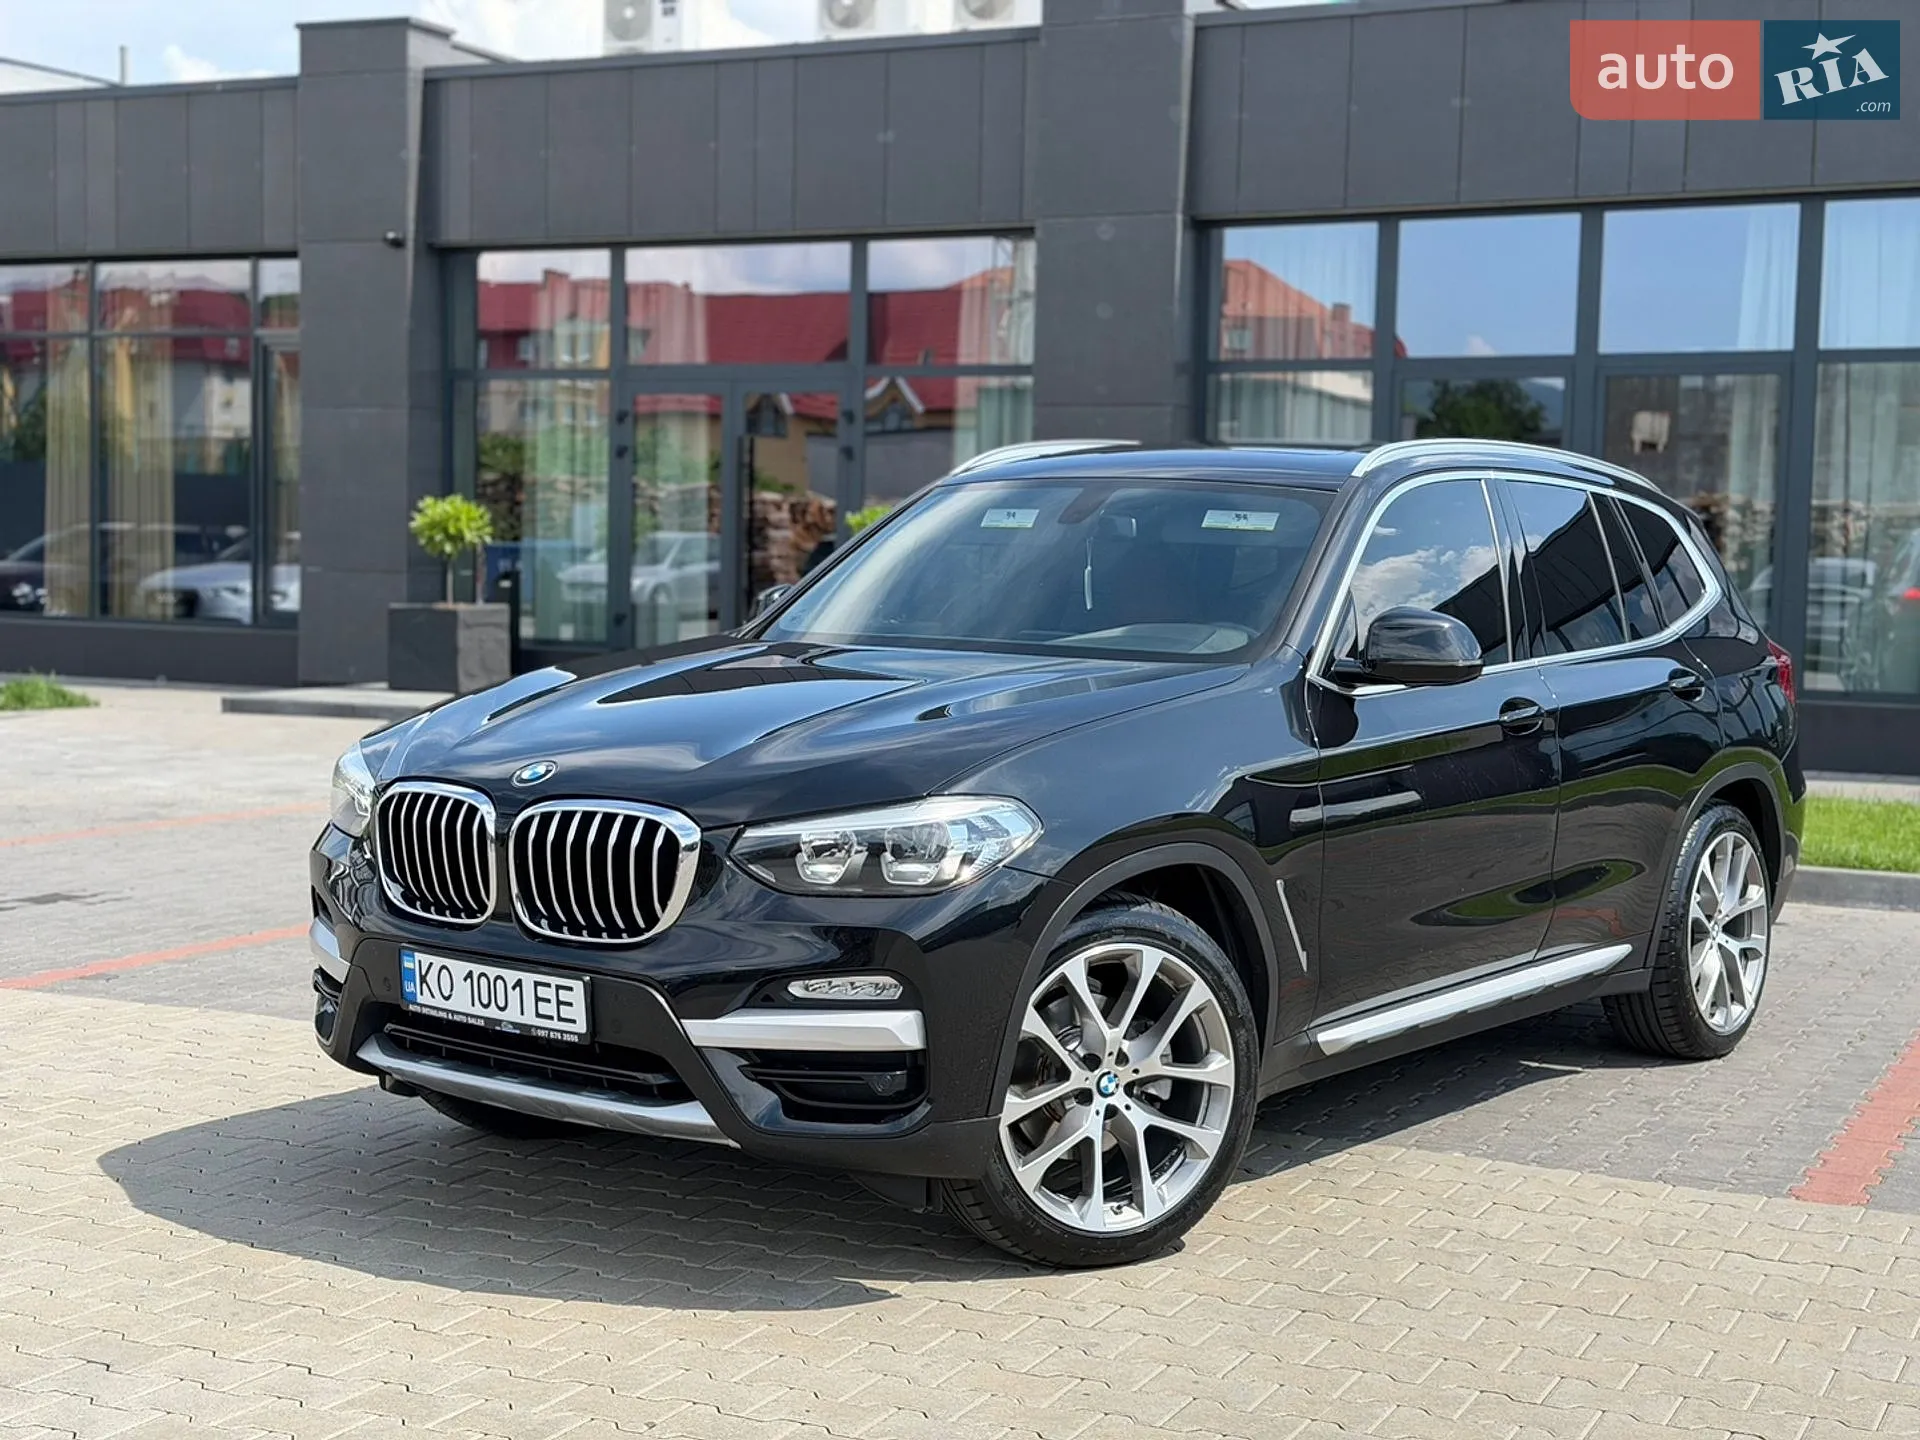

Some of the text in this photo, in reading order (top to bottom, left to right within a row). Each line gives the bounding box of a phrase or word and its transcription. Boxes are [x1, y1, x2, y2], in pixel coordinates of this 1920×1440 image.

[405, 981, 416, 993] UA
[418, 959, 577, 1025] KO 1001 EE
